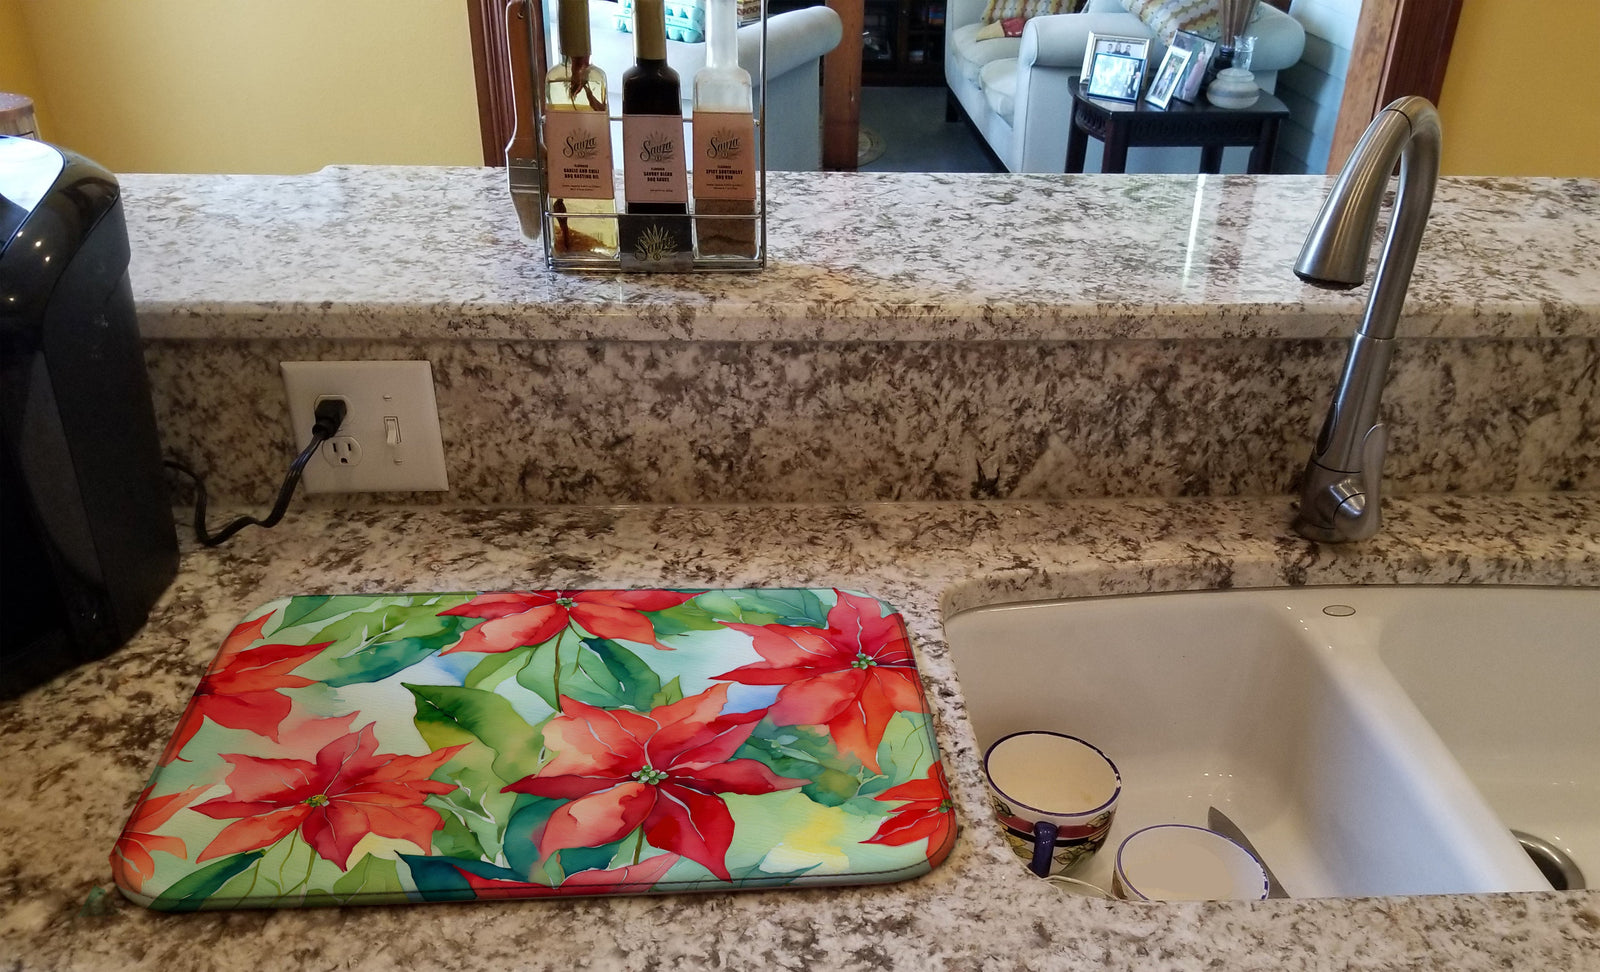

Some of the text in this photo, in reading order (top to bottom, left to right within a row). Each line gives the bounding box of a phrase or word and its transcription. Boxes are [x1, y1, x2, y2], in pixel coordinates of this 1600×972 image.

[563, 136, 597, 158] Sauza
[640, 140, 673, 161] Sauza
[707, 136, 740, 159] Sauza
